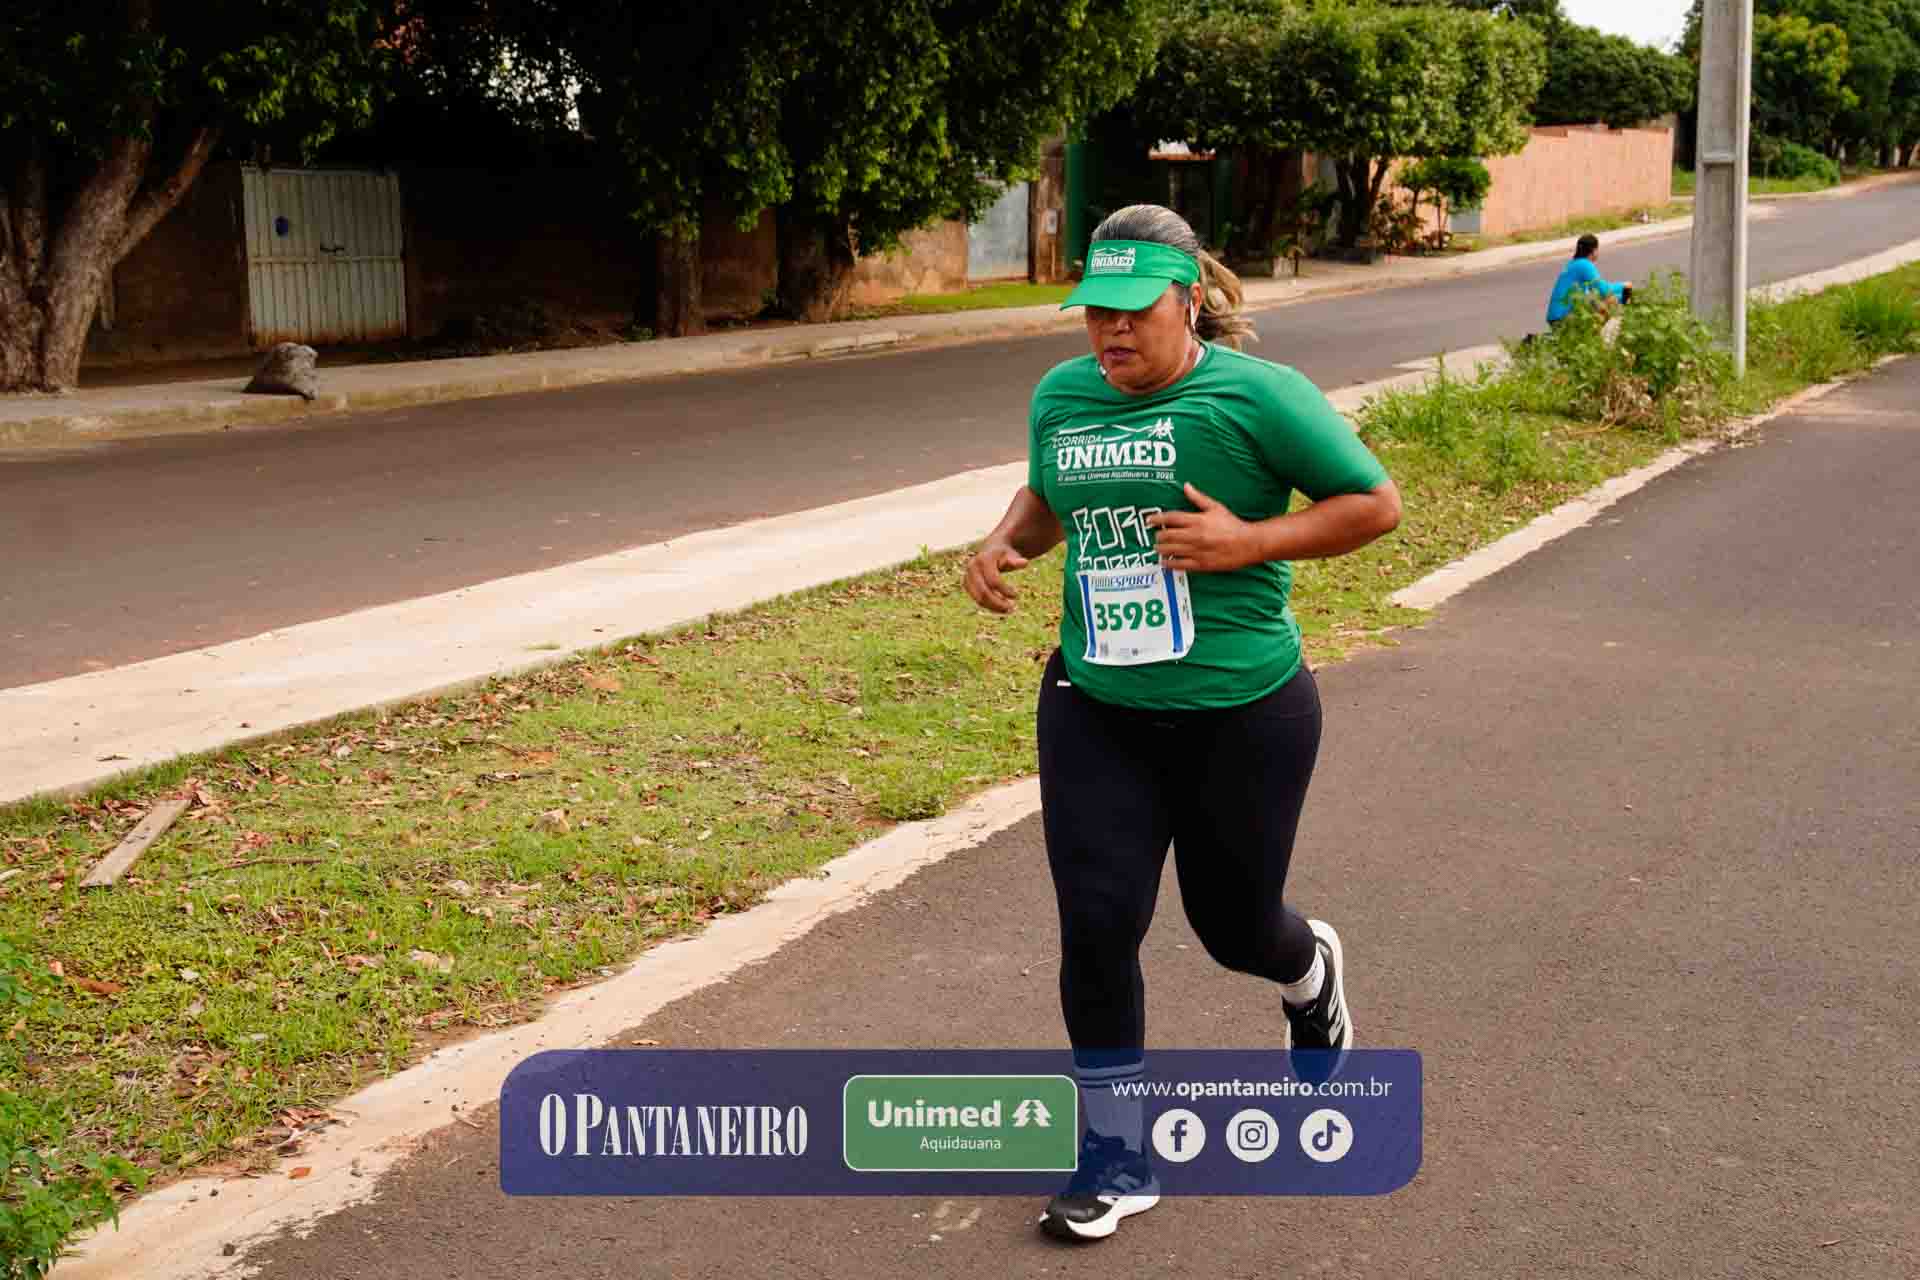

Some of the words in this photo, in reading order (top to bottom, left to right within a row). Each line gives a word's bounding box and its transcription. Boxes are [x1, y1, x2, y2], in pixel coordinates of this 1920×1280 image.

[1091, 255, 1136, 268] UNIMED
[1057, 433, 1104, 447] CORRIDA
[1057, 440, 1177, 470] UNIMED
[1094, 598, 1166, 631] 3598
